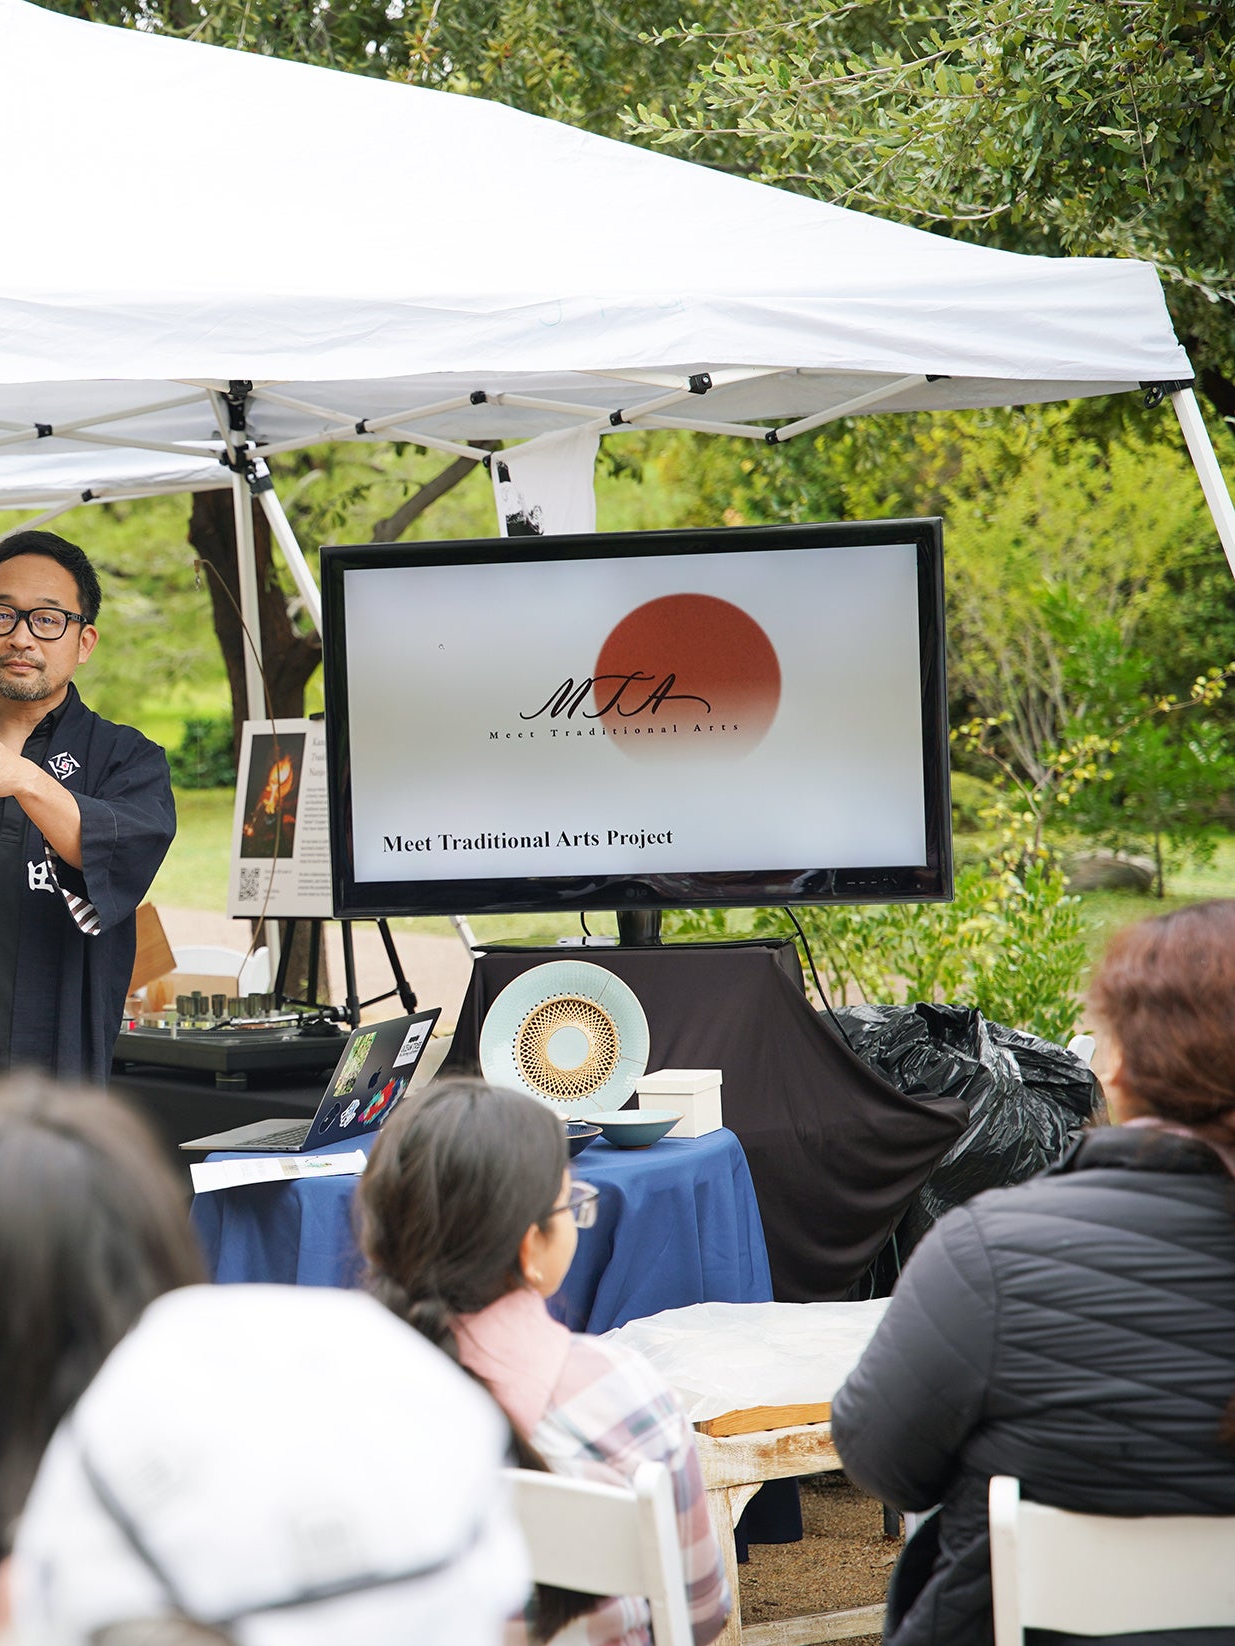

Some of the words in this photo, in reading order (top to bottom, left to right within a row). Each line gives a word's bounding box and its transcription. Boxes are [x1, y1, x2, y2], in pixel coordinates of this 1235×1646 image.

[519, 671, 711, 720] MTA
[489, 730, 535, 740] Meet
[550, 724, 677, 738] Traditional
[693, 723, 739, 732] Arts
[383, 835, 432, 853] Meet
[438, 831, 550, 851] Traditional
[556, 831, 600, 848] Arts
[607, 829, 673, 849] Project
